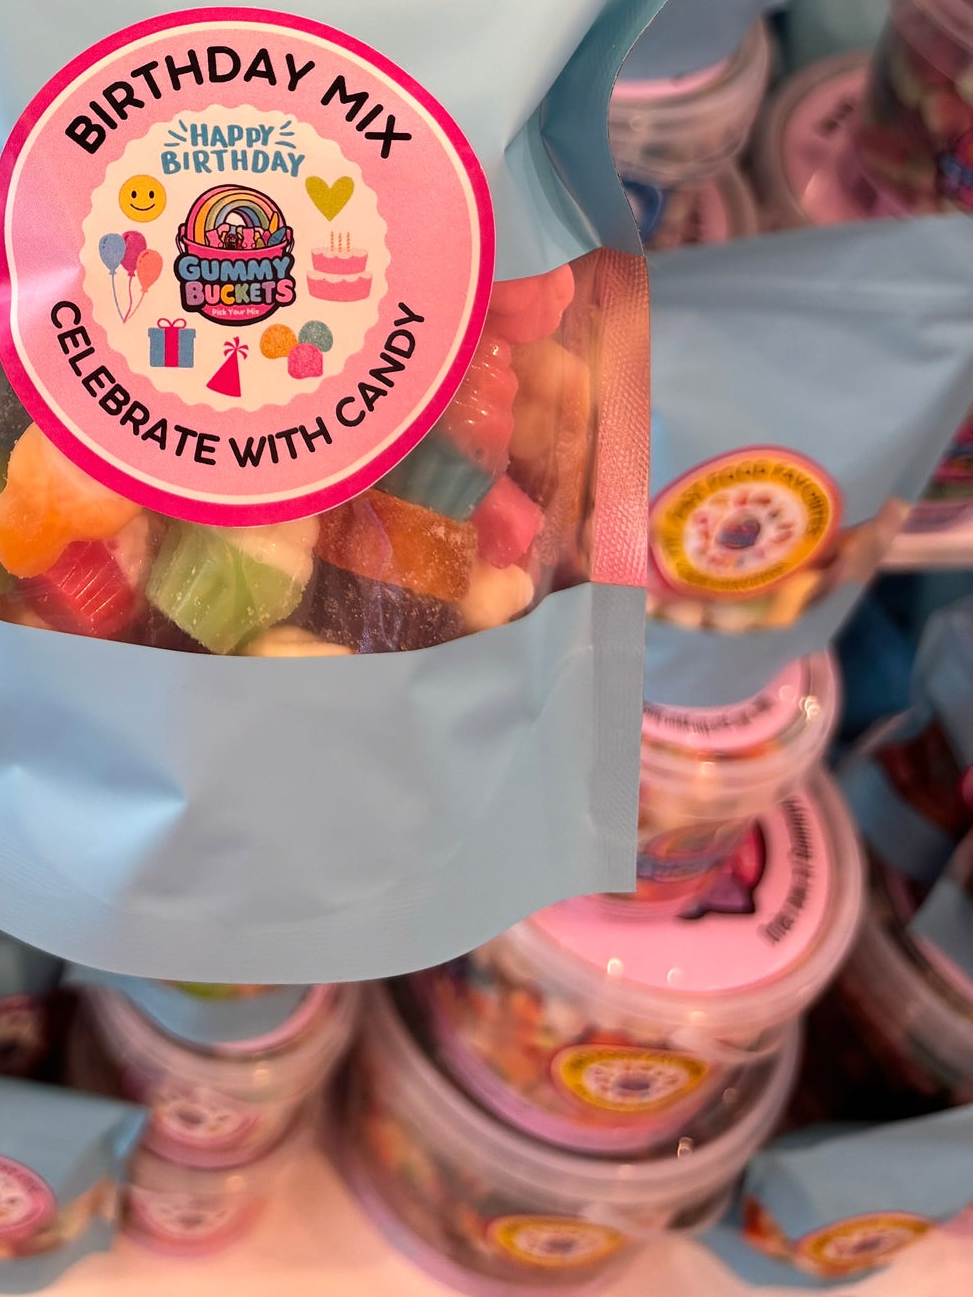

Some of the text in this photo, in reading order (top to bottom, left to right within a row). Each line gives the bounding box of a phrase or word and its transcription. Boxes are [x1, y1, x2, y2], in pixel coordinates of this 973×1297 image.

[64, 45, 413, 160] BIRTHDAY MIX
[189, 122, 276, 149] HAPPY
[160, 150, 307, 178] BIRTHDAY
[178, 255, 291, 282] GUMMY
[184, 278, 295, 307] BUCKETS
[211, 307, 260, 316] Pick Your Mix
[49, 300, 426, 469] CELEBRATE WITH CANDY
